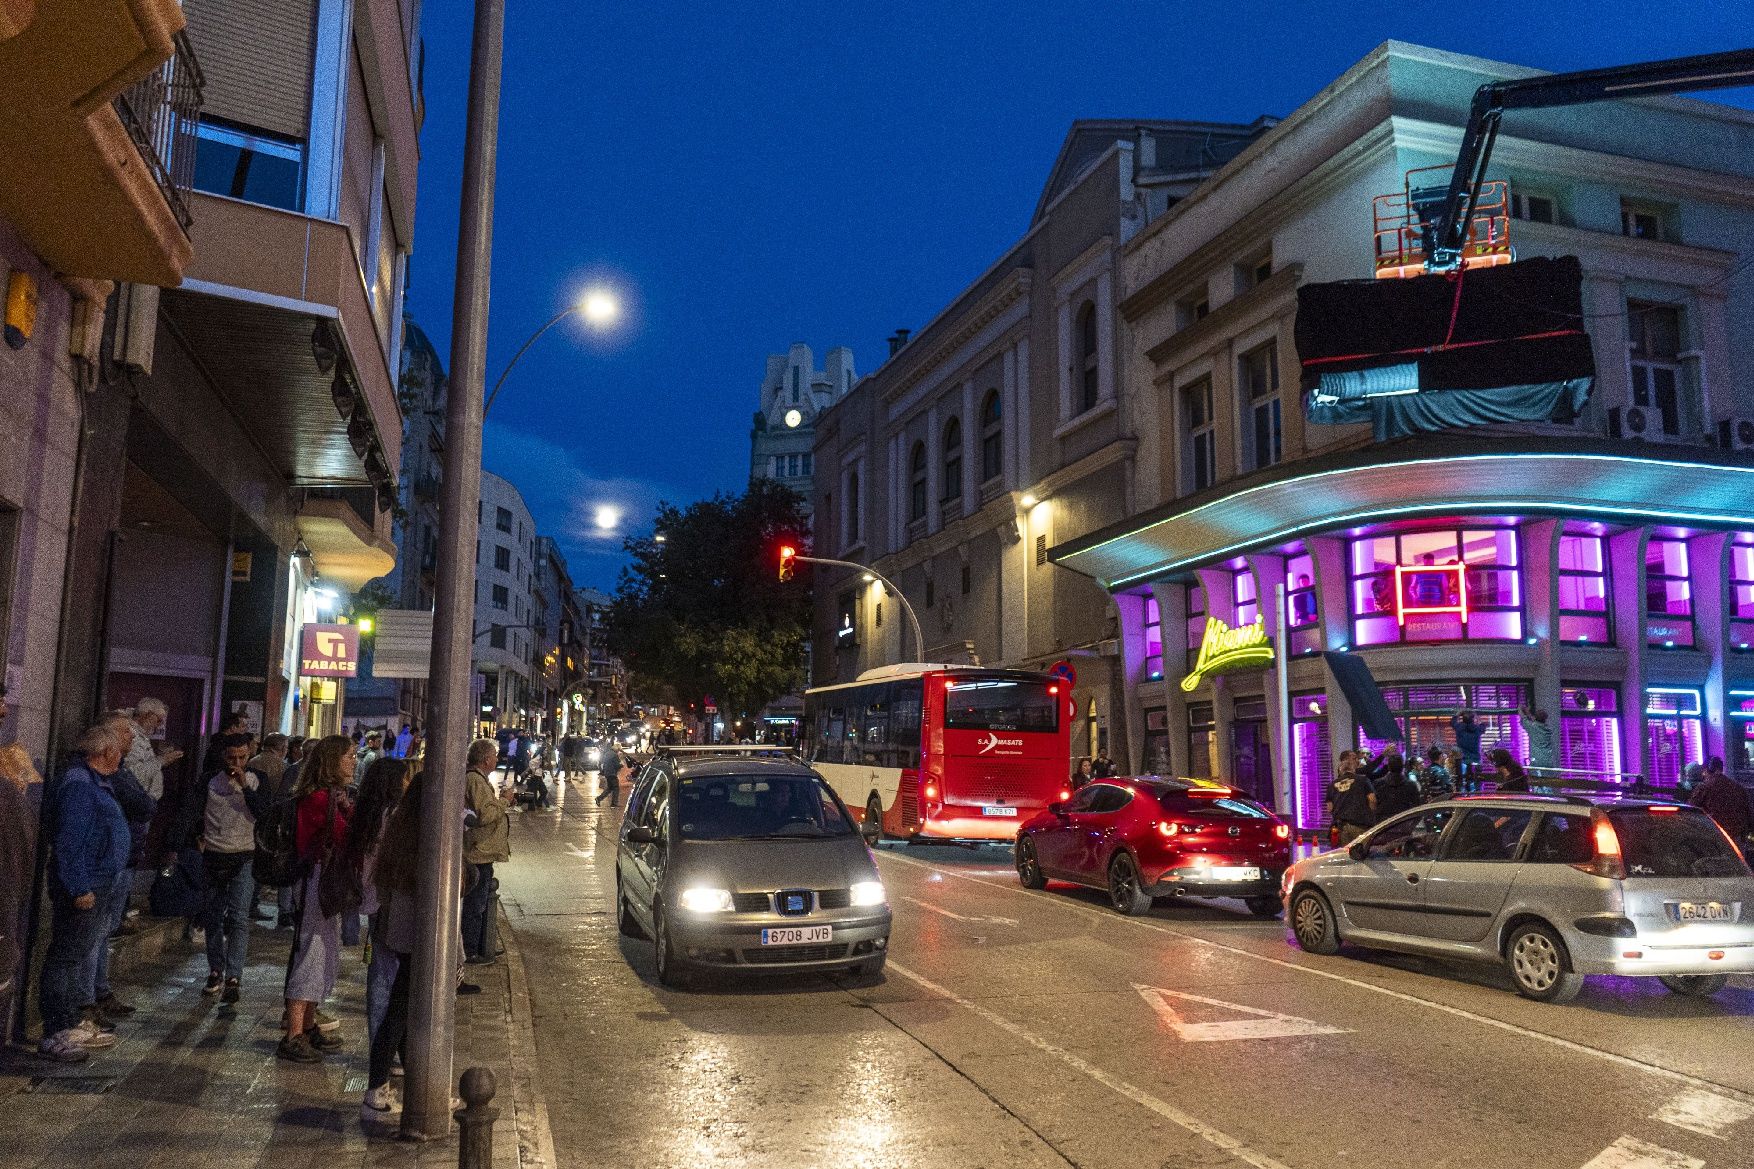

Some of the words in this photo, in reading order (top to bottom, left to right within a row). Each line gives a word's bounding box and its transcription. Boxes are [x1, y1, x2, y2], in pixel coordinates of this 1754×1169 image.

[1190, 614, 1270, 674] Miami
[302, 660, 356, 671] TABACS
[1681, 906, 1708, 919] 2642
[770, 930, 802, 943] 6708
[807, 928, 829, 941] JVB
